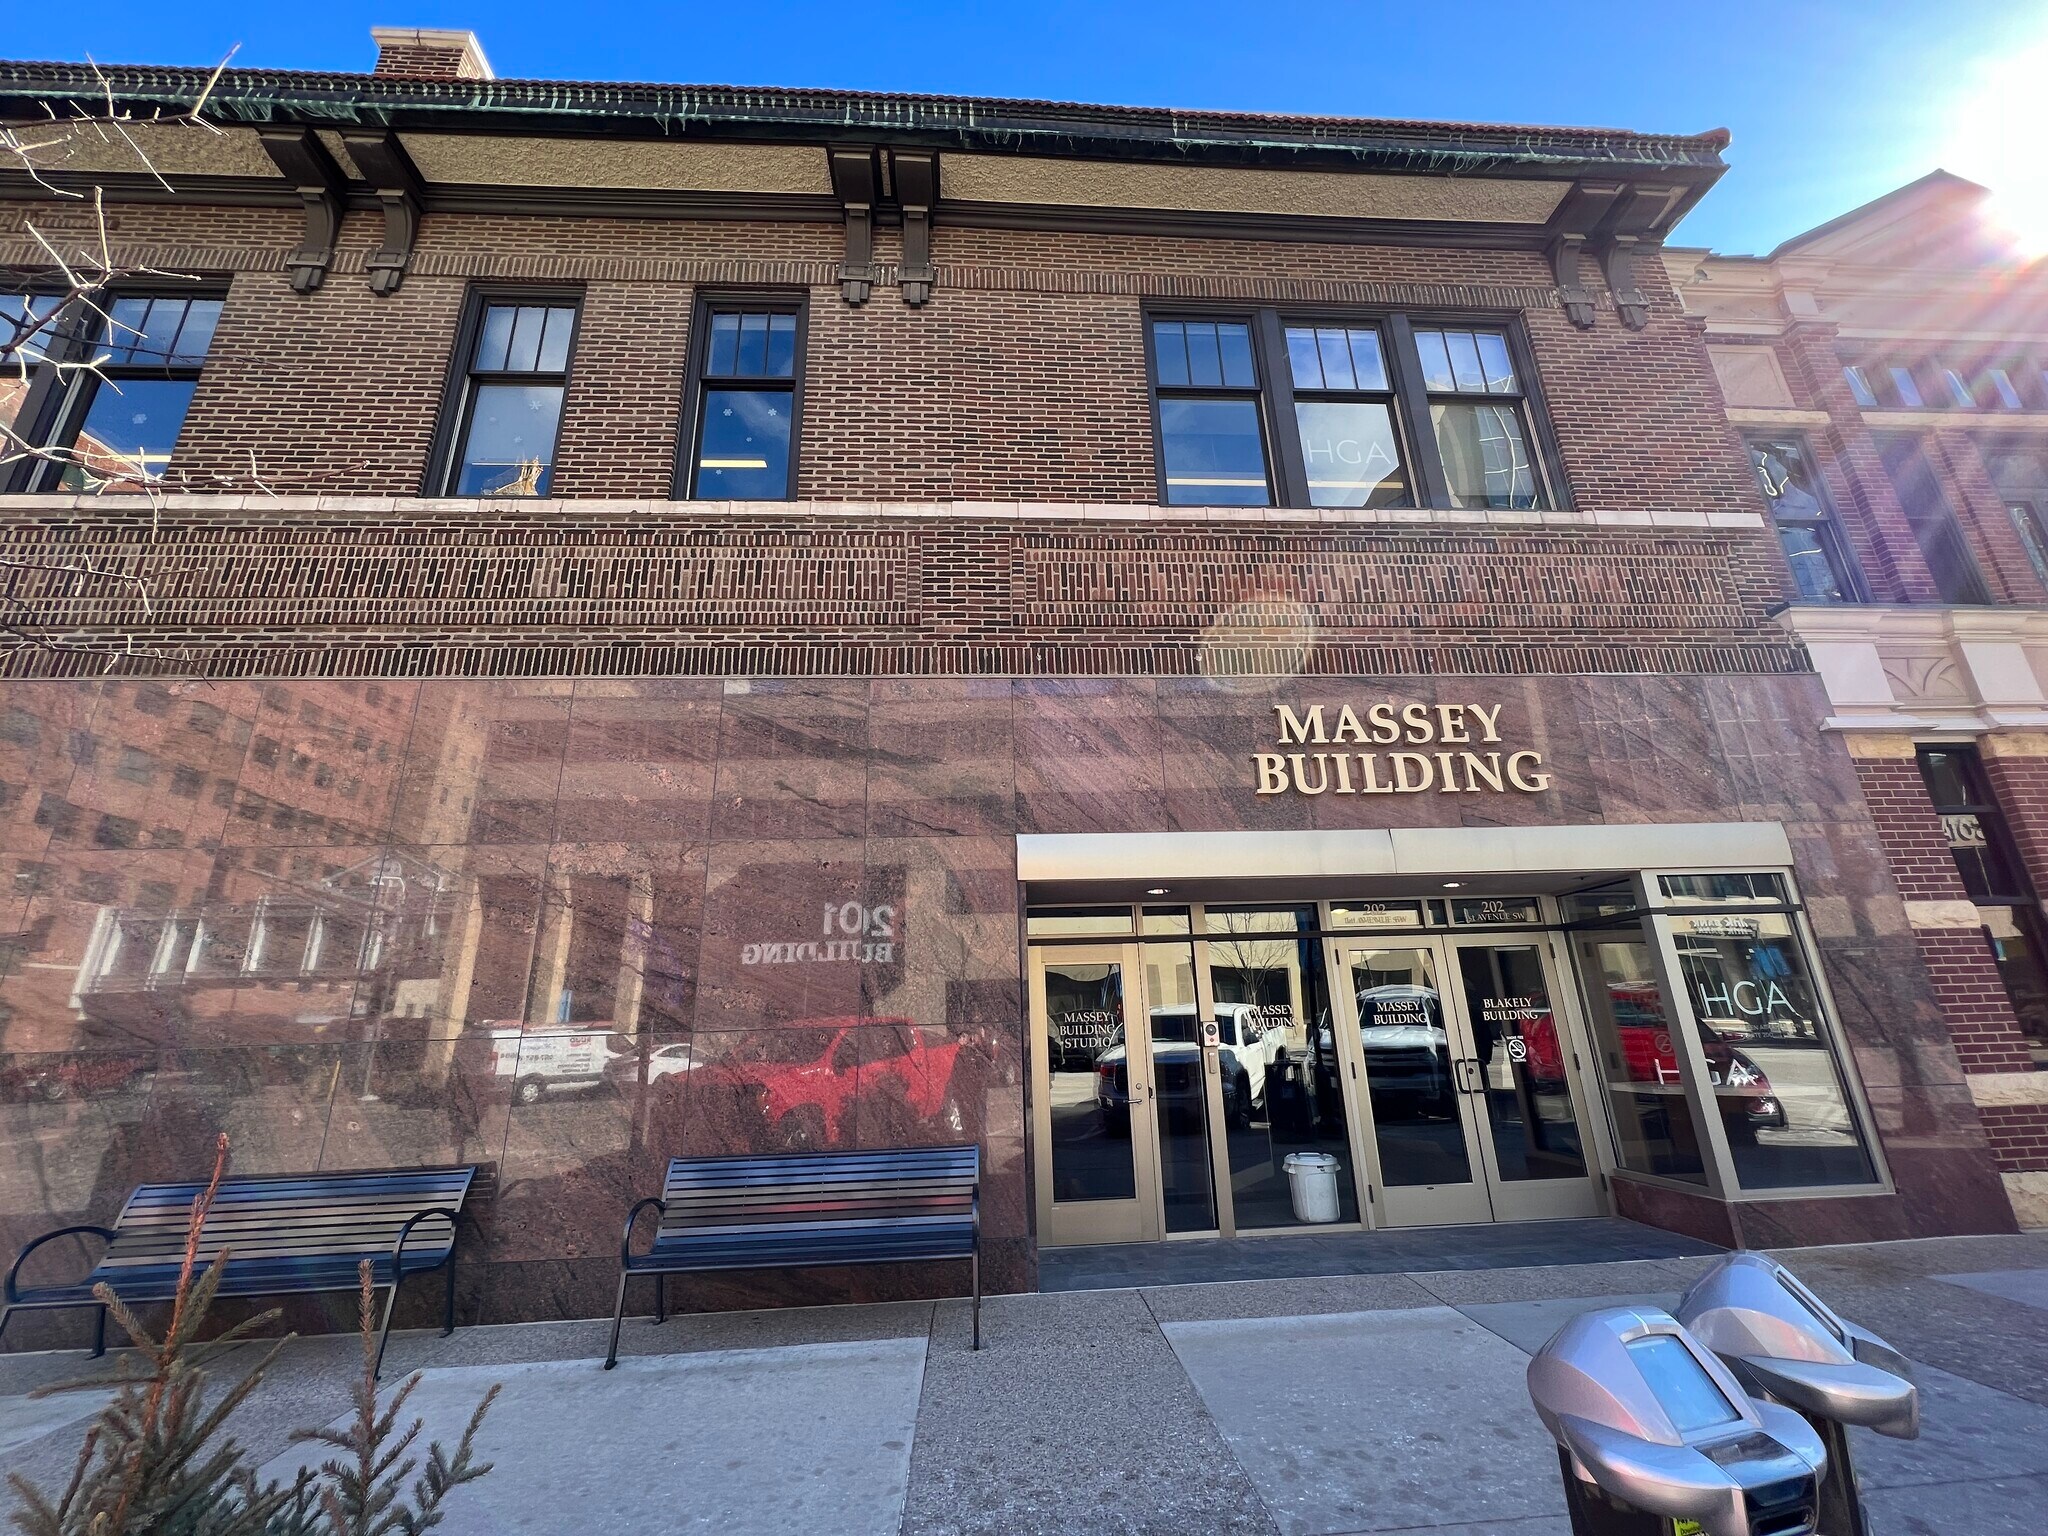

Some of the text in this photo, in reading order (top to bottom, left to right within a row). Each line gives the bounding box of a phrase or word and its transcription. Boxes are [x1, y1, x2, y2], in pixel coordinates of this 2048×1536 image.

[1306, 439, 1391, 465] HGA
[1273, 703, 1503, 746] MASSEY
[1252, 750, 1552, 796] BUILDING
[1363, 903, 1387, 916] 202
[1481, 900, 1505, 913] 202
[1477, 912, 1511, 921] AVENUE
[1512, 911, 1526, 920] SW
[1482, 997, 1532, 1009] BLAKELY
[1700, 980, 1797, 1016] HGA
[1376, 1001, 1420, 1012] MASSEY
[1064, 1011, 1110, 1023] MASSEY
[1373, 1012, 1427, 1025] BUILDING
[1482, 1009, 1538, 1021] BUILDING
[1248, 1016, 1297, 1028] UILDING
[1060, 1023, 1115, 1036] BUILDING
[1064, 1036, 1111, 1049] STUDIO
